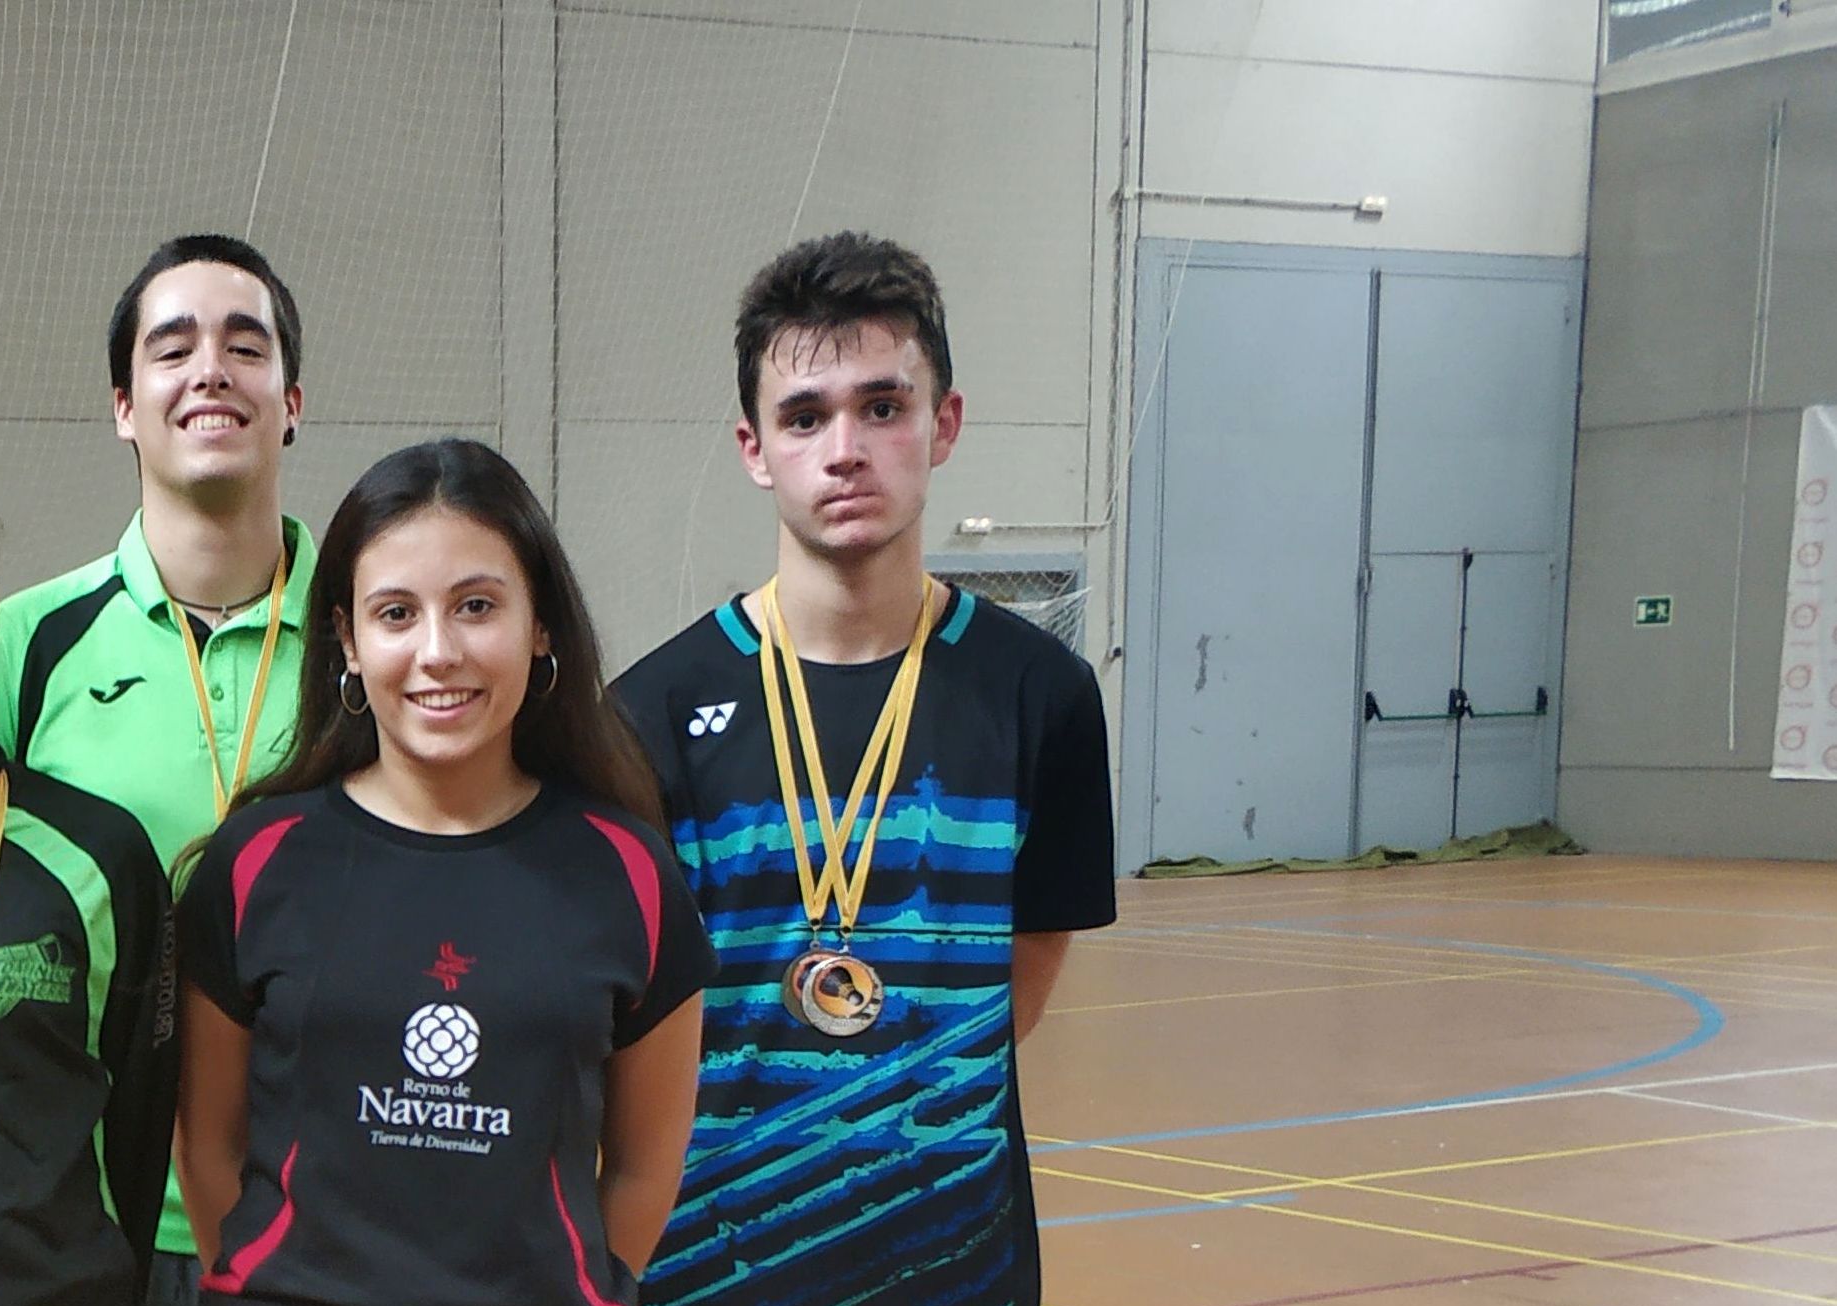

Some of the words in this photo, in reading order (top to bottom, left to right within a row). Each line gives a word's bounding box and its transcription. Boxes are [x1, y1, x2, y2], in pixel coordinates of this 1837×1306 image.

[402, 1077, 451, 1098] Reyno
[452, 1081, 472, 1099] de
[357, 1085, 511, 1136] Navarra
[369, 1129, 409, 1146] Tierra
[409, 1132, 424, 1148] de
[424, 1133, 492, 1154] Diversidad
